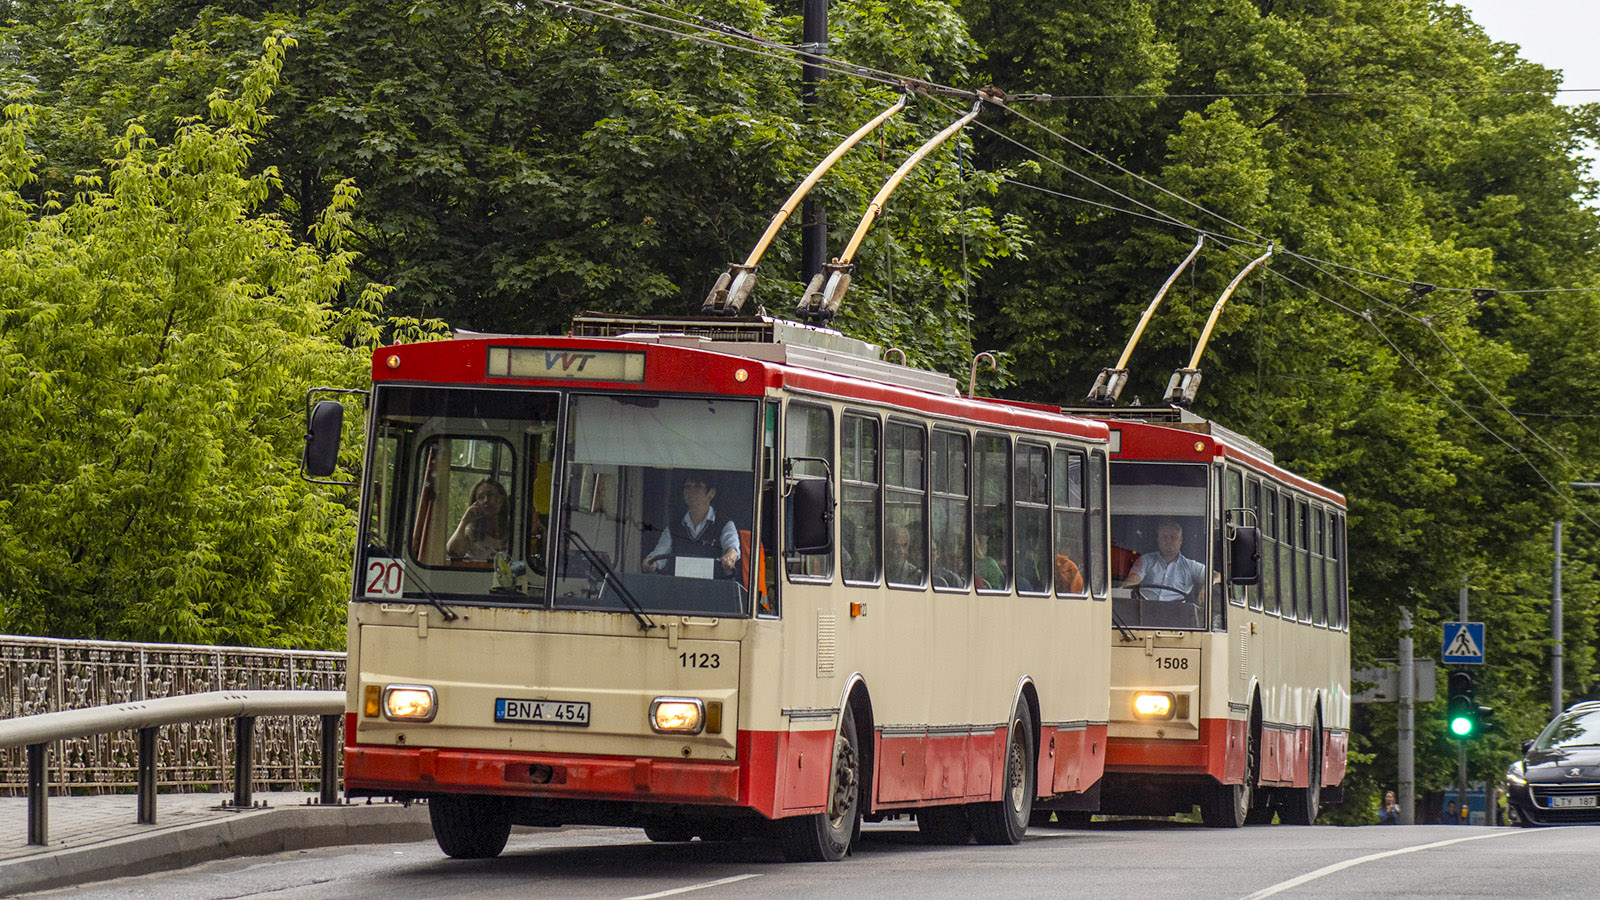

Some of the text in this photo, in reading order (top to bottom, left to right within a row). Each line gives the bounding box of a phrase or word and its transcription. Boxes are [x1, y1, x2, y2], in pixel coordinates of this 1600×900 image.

[545, 351, 596, 371] VVT
[367, 561, 402, 594] 20
[679, 652, 720, 668] 1123
[1155, 657, 1188, 669] 1508
[507, 702, 585, 720] BNA 454
[1553, 797, 1594, 806] LTY 187
